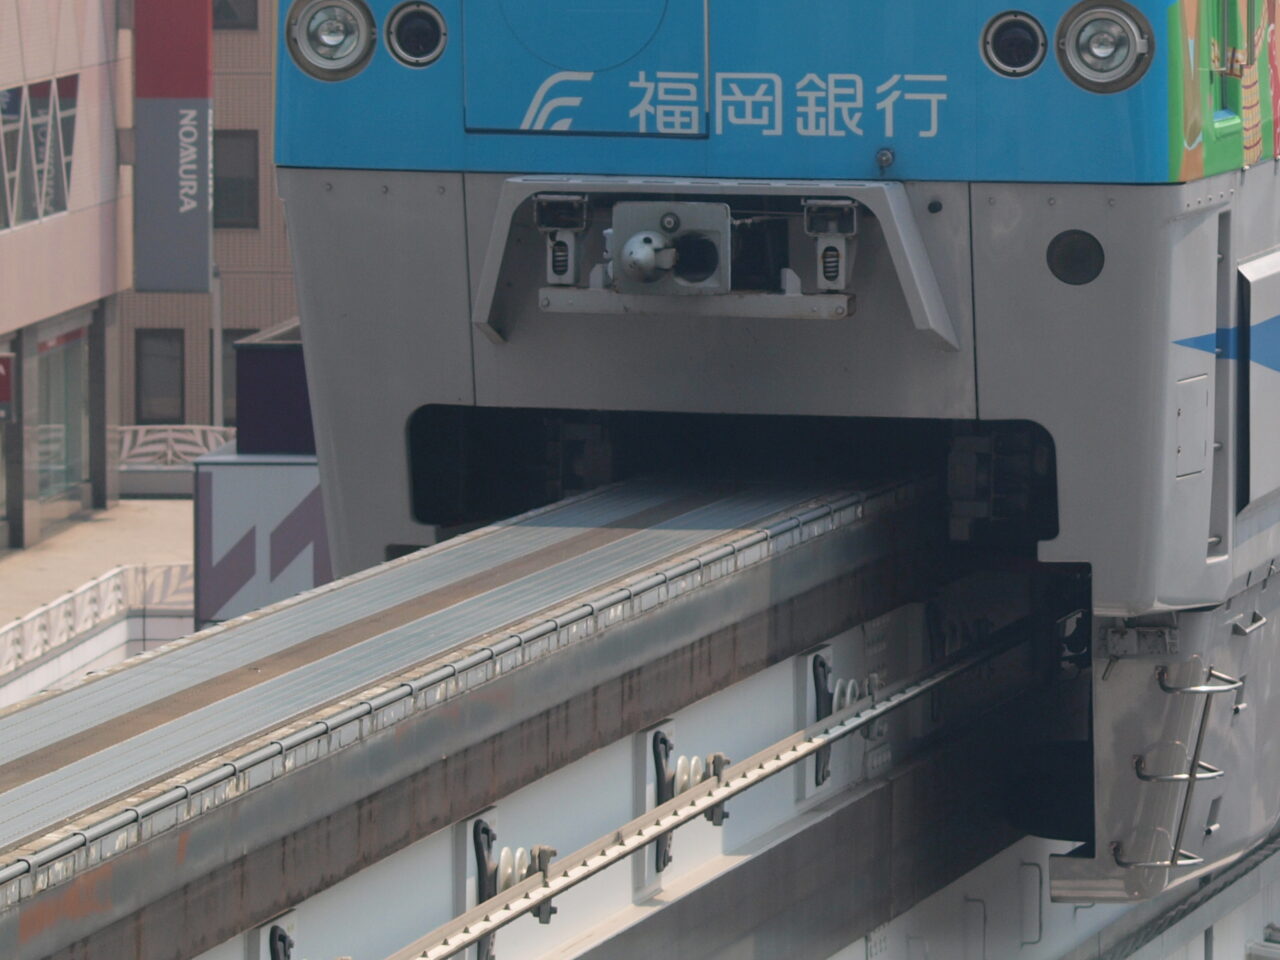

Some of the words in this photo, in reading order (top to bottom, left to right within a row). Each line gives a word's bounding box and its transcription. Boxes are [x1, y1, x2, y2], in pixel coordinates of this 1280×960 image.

[628, 70, 948, 137] 福岡銀行
[179, 108, 199, 213] NOMURA
